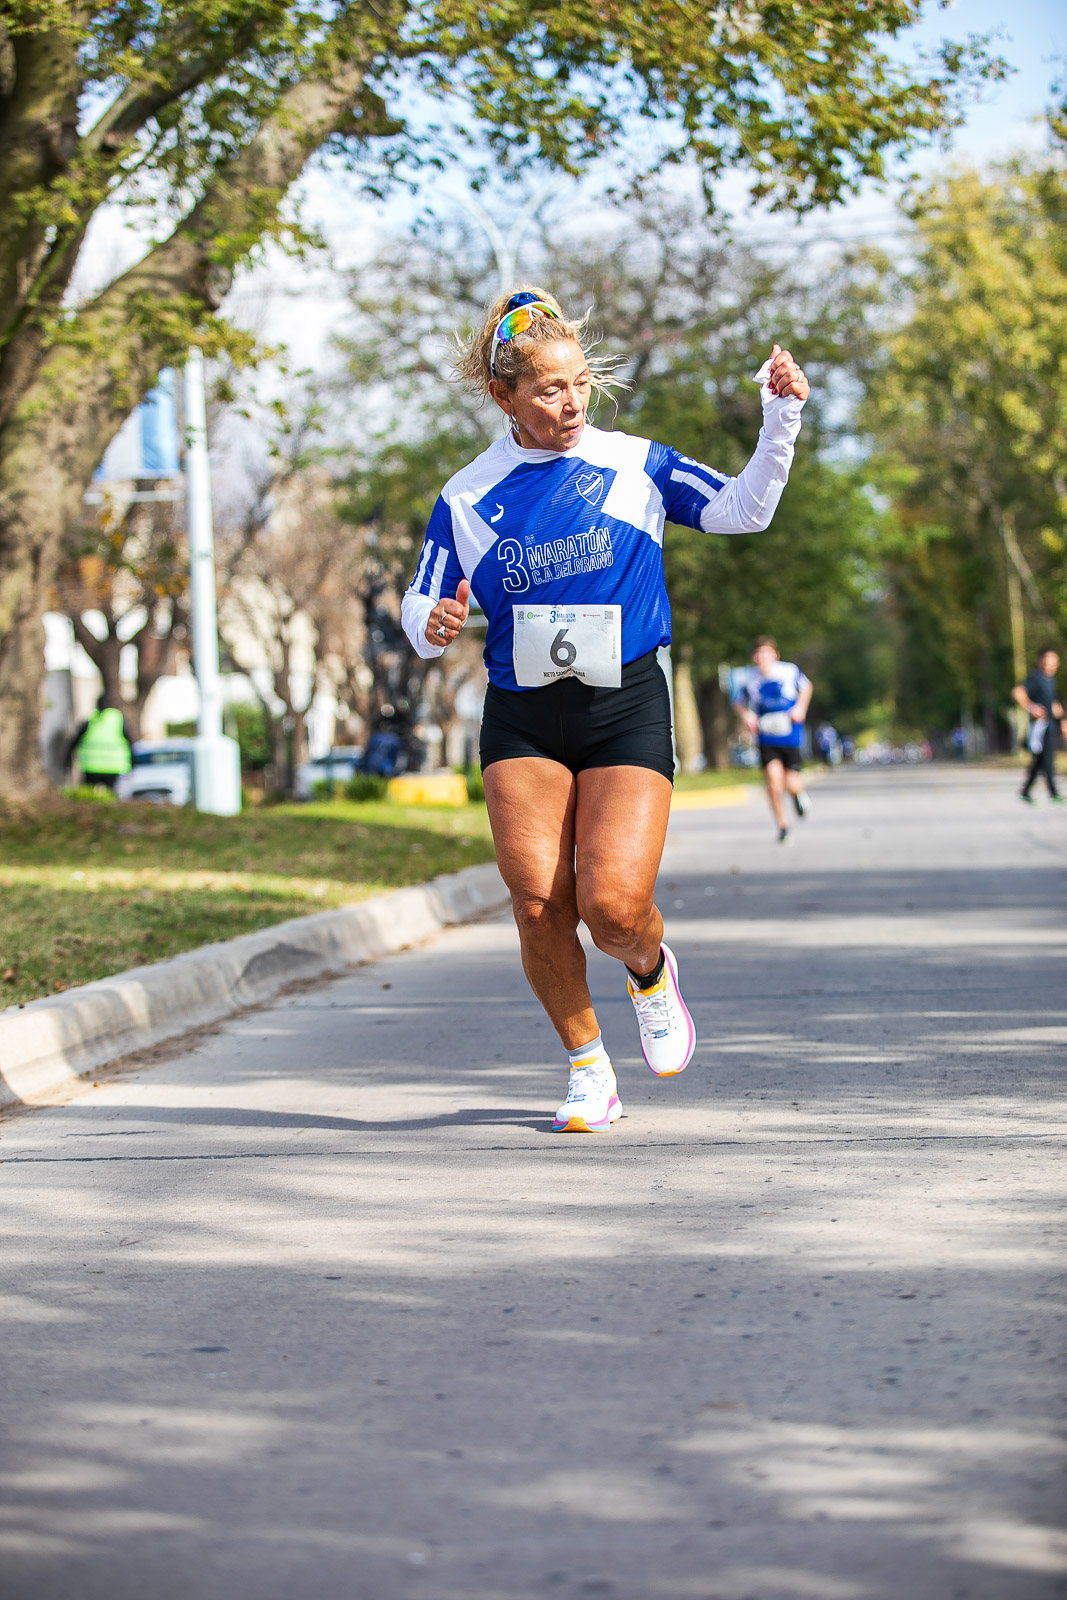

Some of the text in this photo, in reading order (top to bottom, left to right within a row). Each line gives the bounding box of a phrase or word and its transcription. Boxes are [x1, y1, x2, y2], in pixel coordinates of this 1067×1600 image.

[497, 526, 612, 593] 3 MARATÓN
[550, 628, 577, 668] 6
